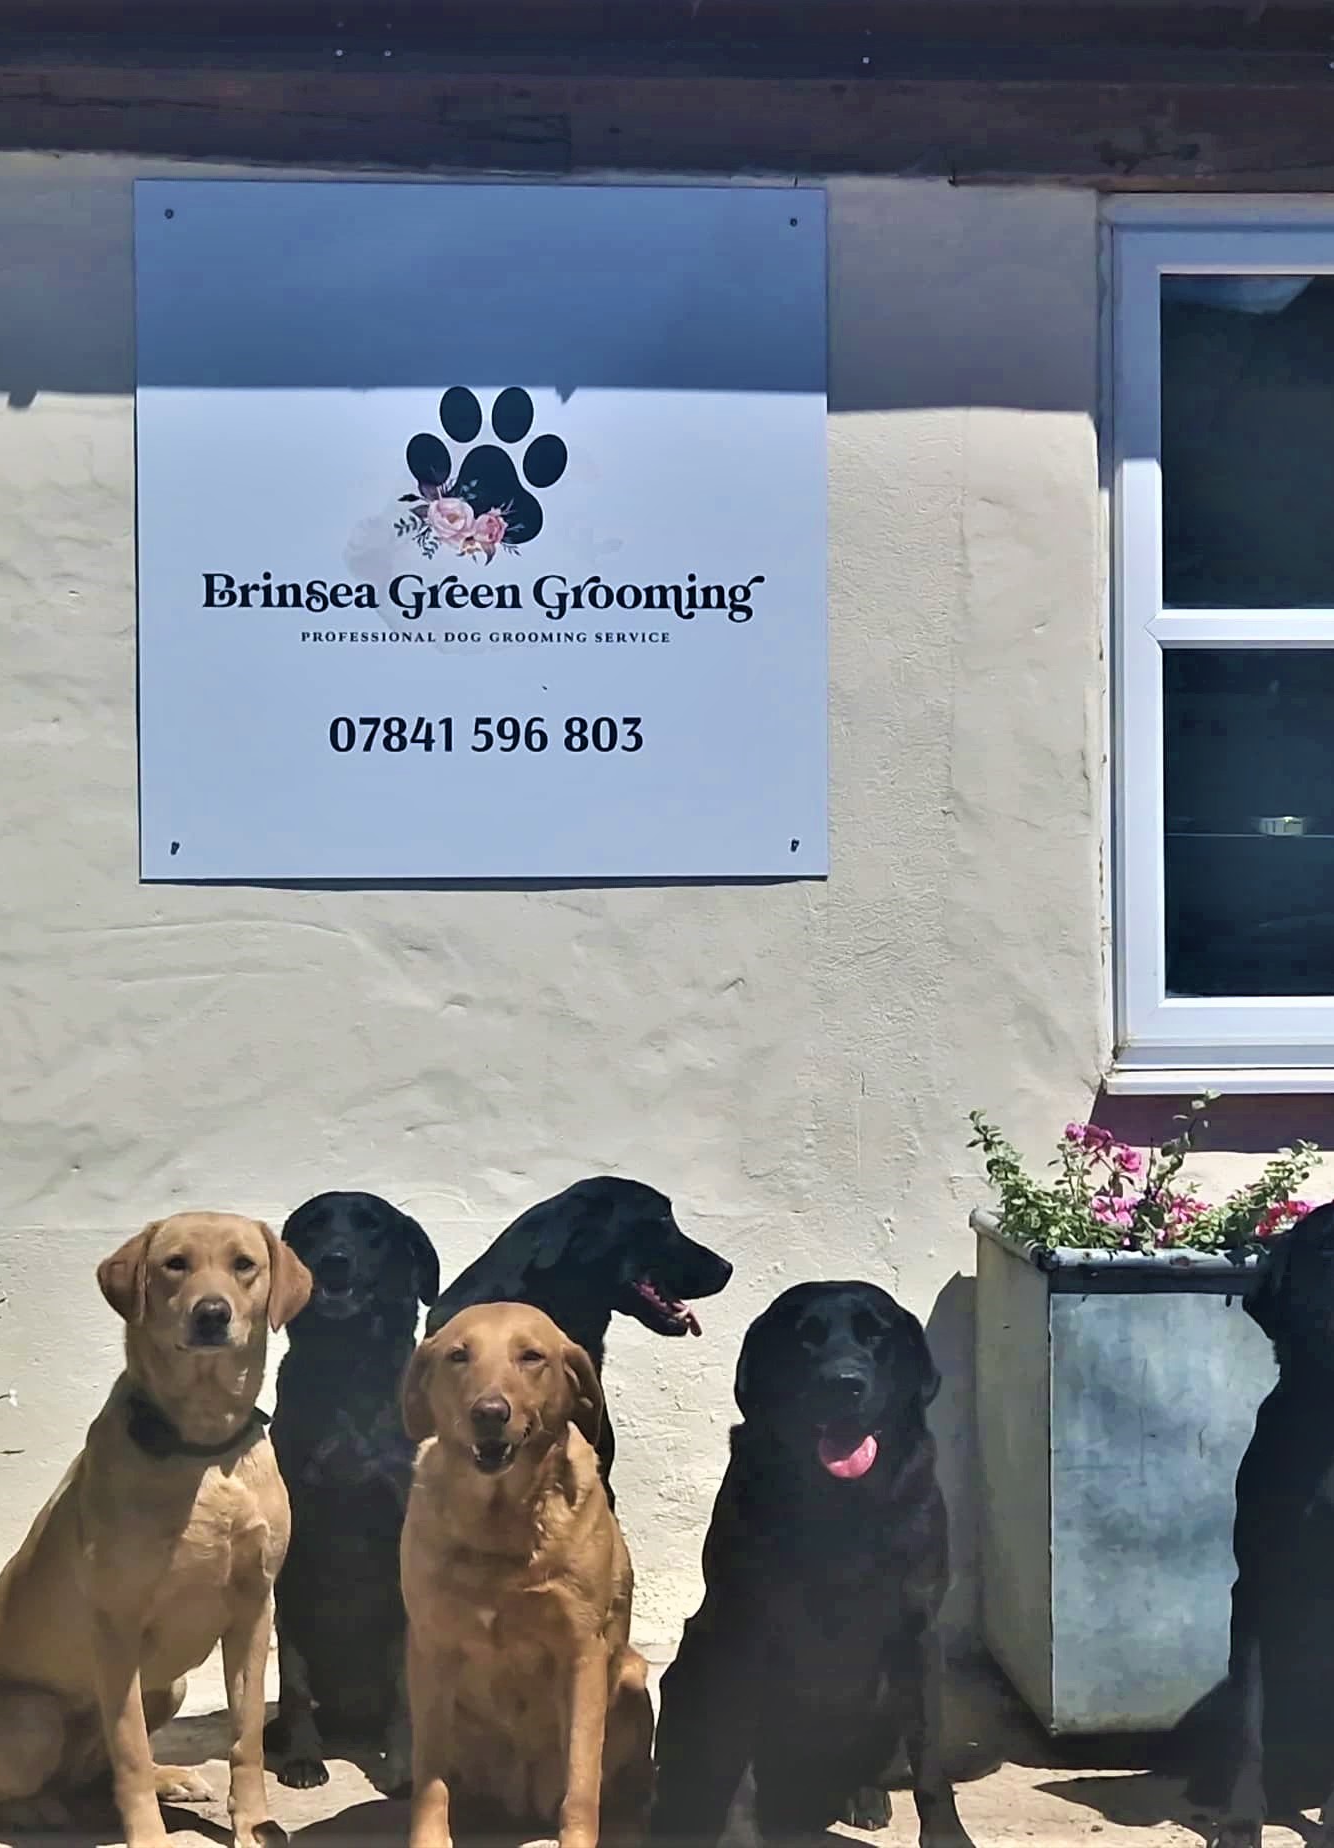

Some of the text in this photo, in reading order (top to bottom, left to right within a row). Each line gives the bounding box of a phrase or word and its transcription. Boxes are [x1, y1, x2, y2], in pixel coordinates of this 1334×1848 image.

[202, 572, 766, 623] Brinsea Green Grooming
[301, 631, 671, 643] PROFESSIONAL DOG GROOMING SERVICE
[329, 716, 644, 753] 07841 596 803
